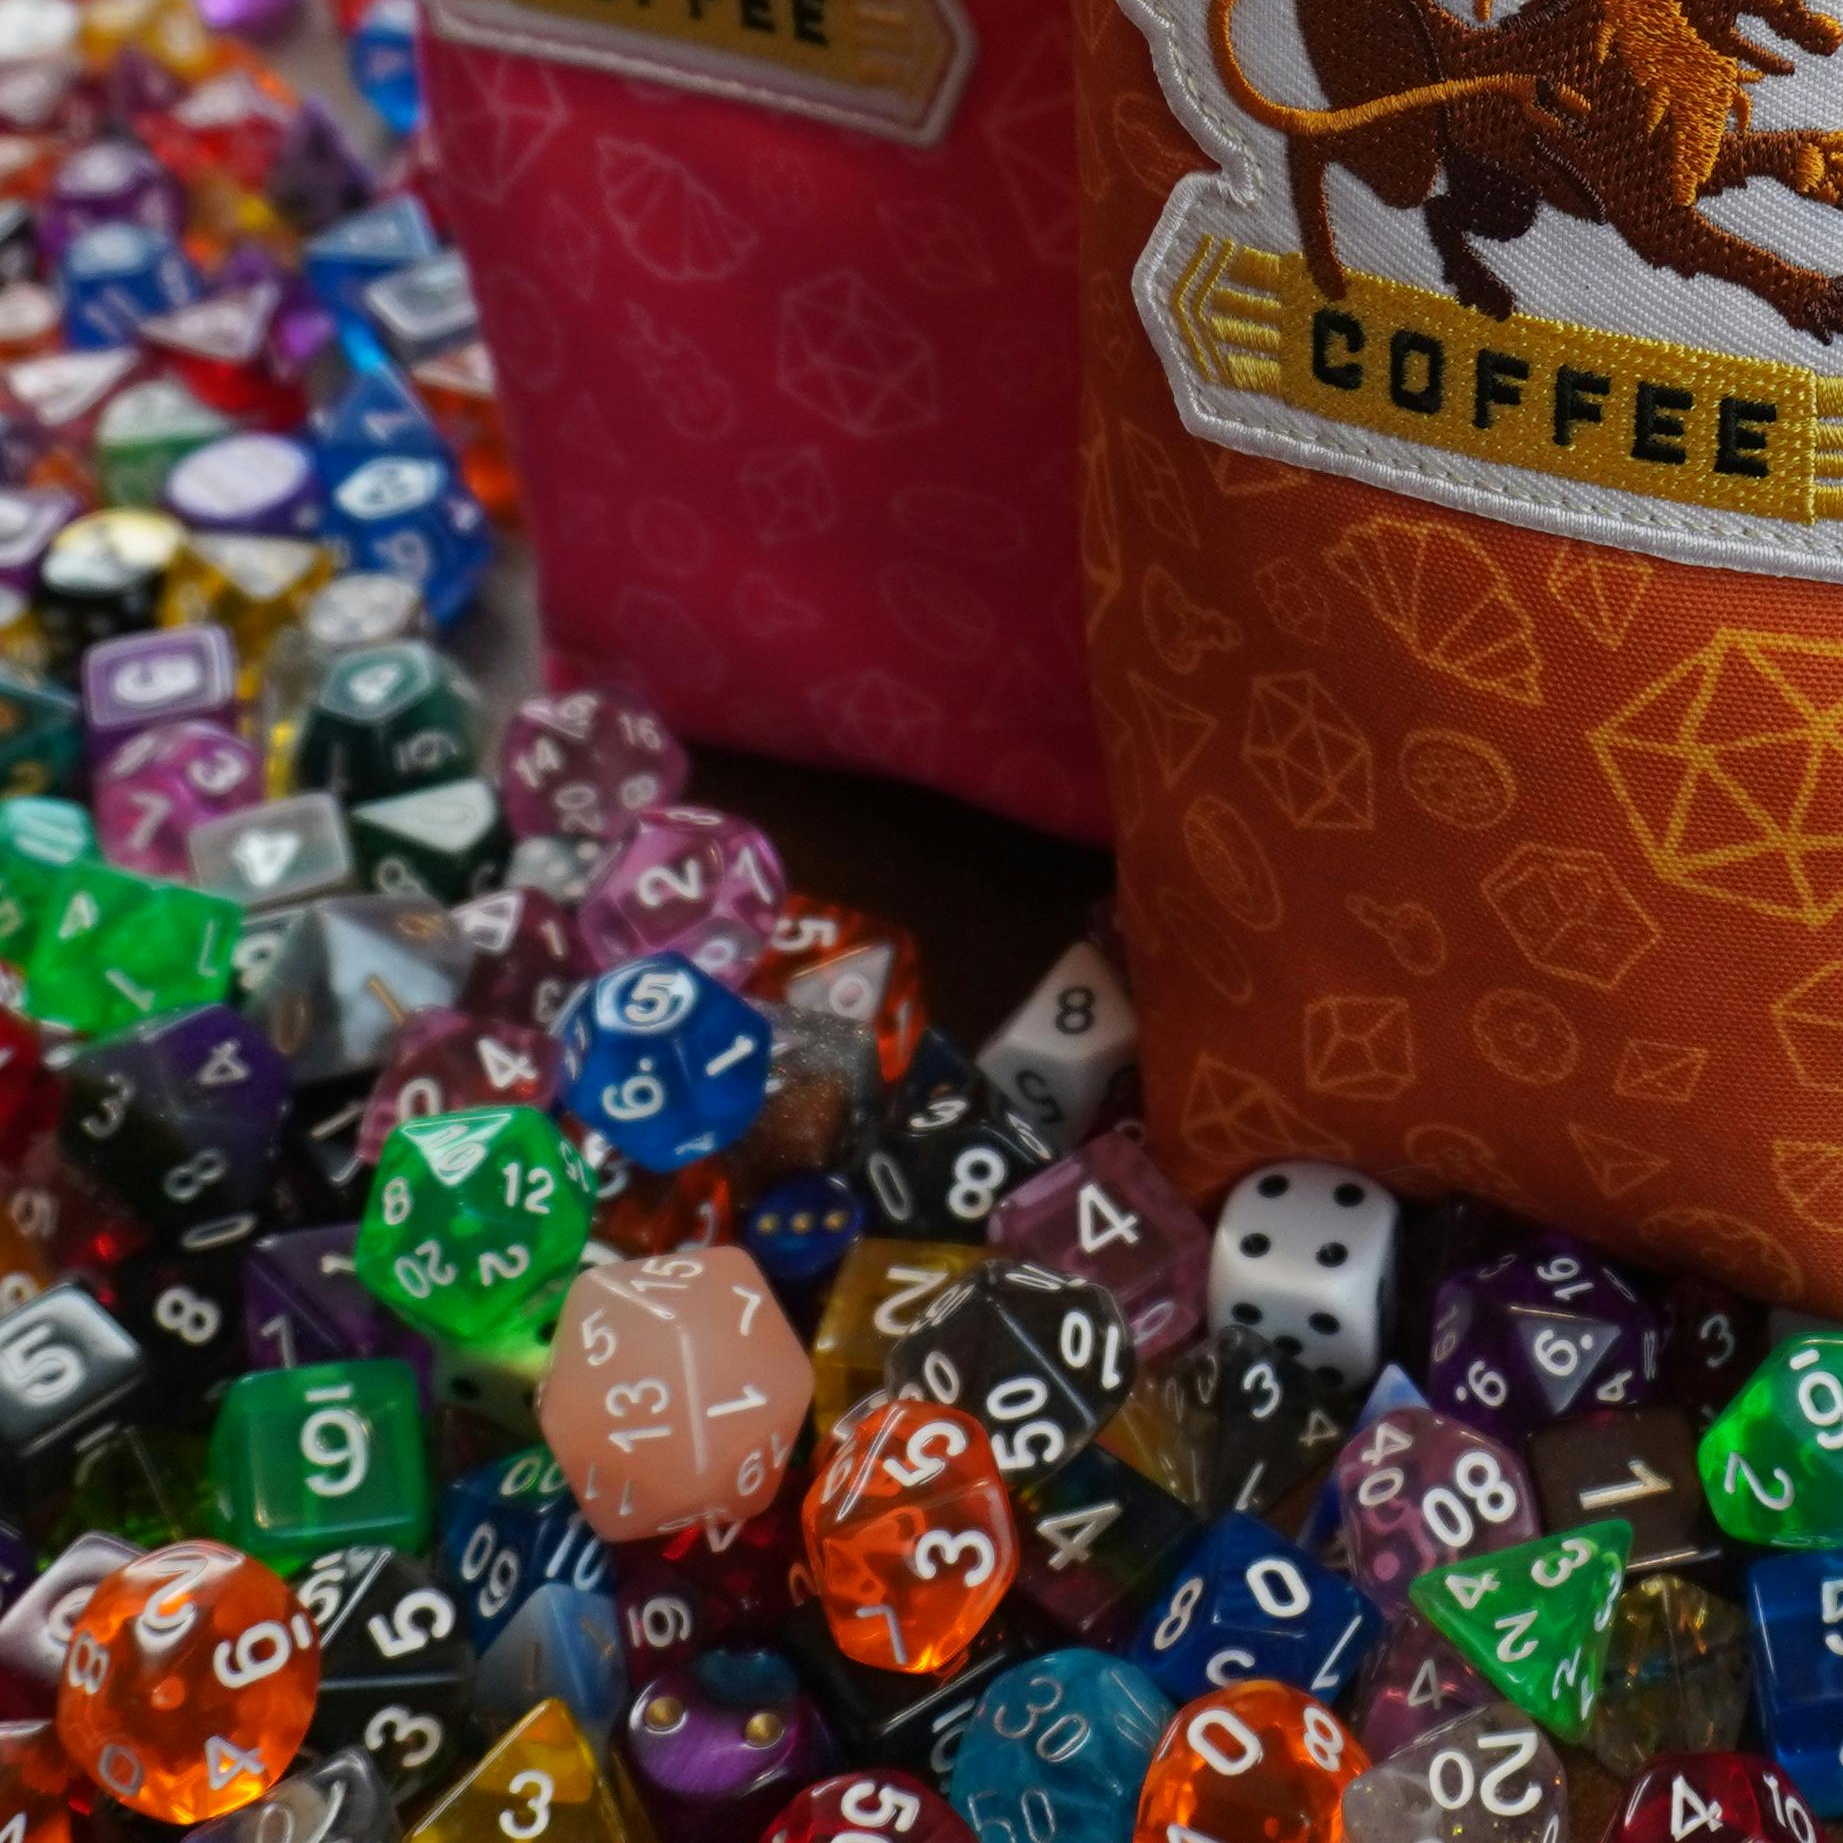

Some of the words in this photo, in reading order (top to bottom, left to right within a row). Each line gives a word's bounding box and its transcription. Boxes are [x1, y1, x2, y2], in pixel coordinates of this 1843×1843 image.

[1313, 308, 1780, 481] COFFEE
[638, 860, 699, 908] 2
[771, 918, 837, 952] 5
[625, 973, 685, 1023] 5
[1056, 987, 1095, 1035] 8
[164, 1149, 226, 1201] 8
[383, 1176, 412, 1225] 8
[502, 1162, 555, 1215] 12
[948, 1147, 1006, 1220] 8
[1078, 1183, 1139, 1254] 4
[395, 1239, 456, 1299] 20
[479, 1244, 530, 1286] 2
[630, 1258, 704, 1294] 15
[154, 1286, 221, 1345] 8
[874, 1267, 949, 1335] 2
[5, 1322, 85, 1404] 5
[580, 1309, 619, 1366] 5
[1060, 1311, 1120, 1389] 10
[1700, 1313, 1735, 1368] 3
[605, 1377, 672, 1454] 13
[707, 1384, 768, 1418] 1
[1243, 1363, 1281, 1419] 3
[1597, 1370, 1633, 1403] 4
[987, 1377, 1063, 1471] 50
[883, 1421, 968, 1487] 5
[1724, 1453, 1794, 1511] 2
[1422, 1451, 1517, 1547] 80
[1579, 1460, 1672, 1510] 1
[914, 1529, 996, 1588] 3
[1038, 1501, 1122, 1570] 4
[1532, 1539, 1592, 1588] 3
[1153, 1576, 1203, 1650] 8
[1246, 1558, 1310, 1617] 0
[1445, 1571, 1500, 1609] 4
[368, 1589, 456, 1657] 5
[1496, 1610, 1539, 1662] 2
[1408, 1659, 1451, 1709] 4
[365, 1704, 443, 1766] 3
[993, 1677, 1091, 1762] 30
[1186, 1707, 1262, 1776] 0
[1304, 1706, 1344, 1772] 8
[205, 1734, 266, 1790] 4
[1429, 1729, 1543, 1816] 20
[500, 1770, 553, 1839] 3
[1671, 1770, 1722, 1841] 4
[1763, 1773, 1816, 1843] 10
